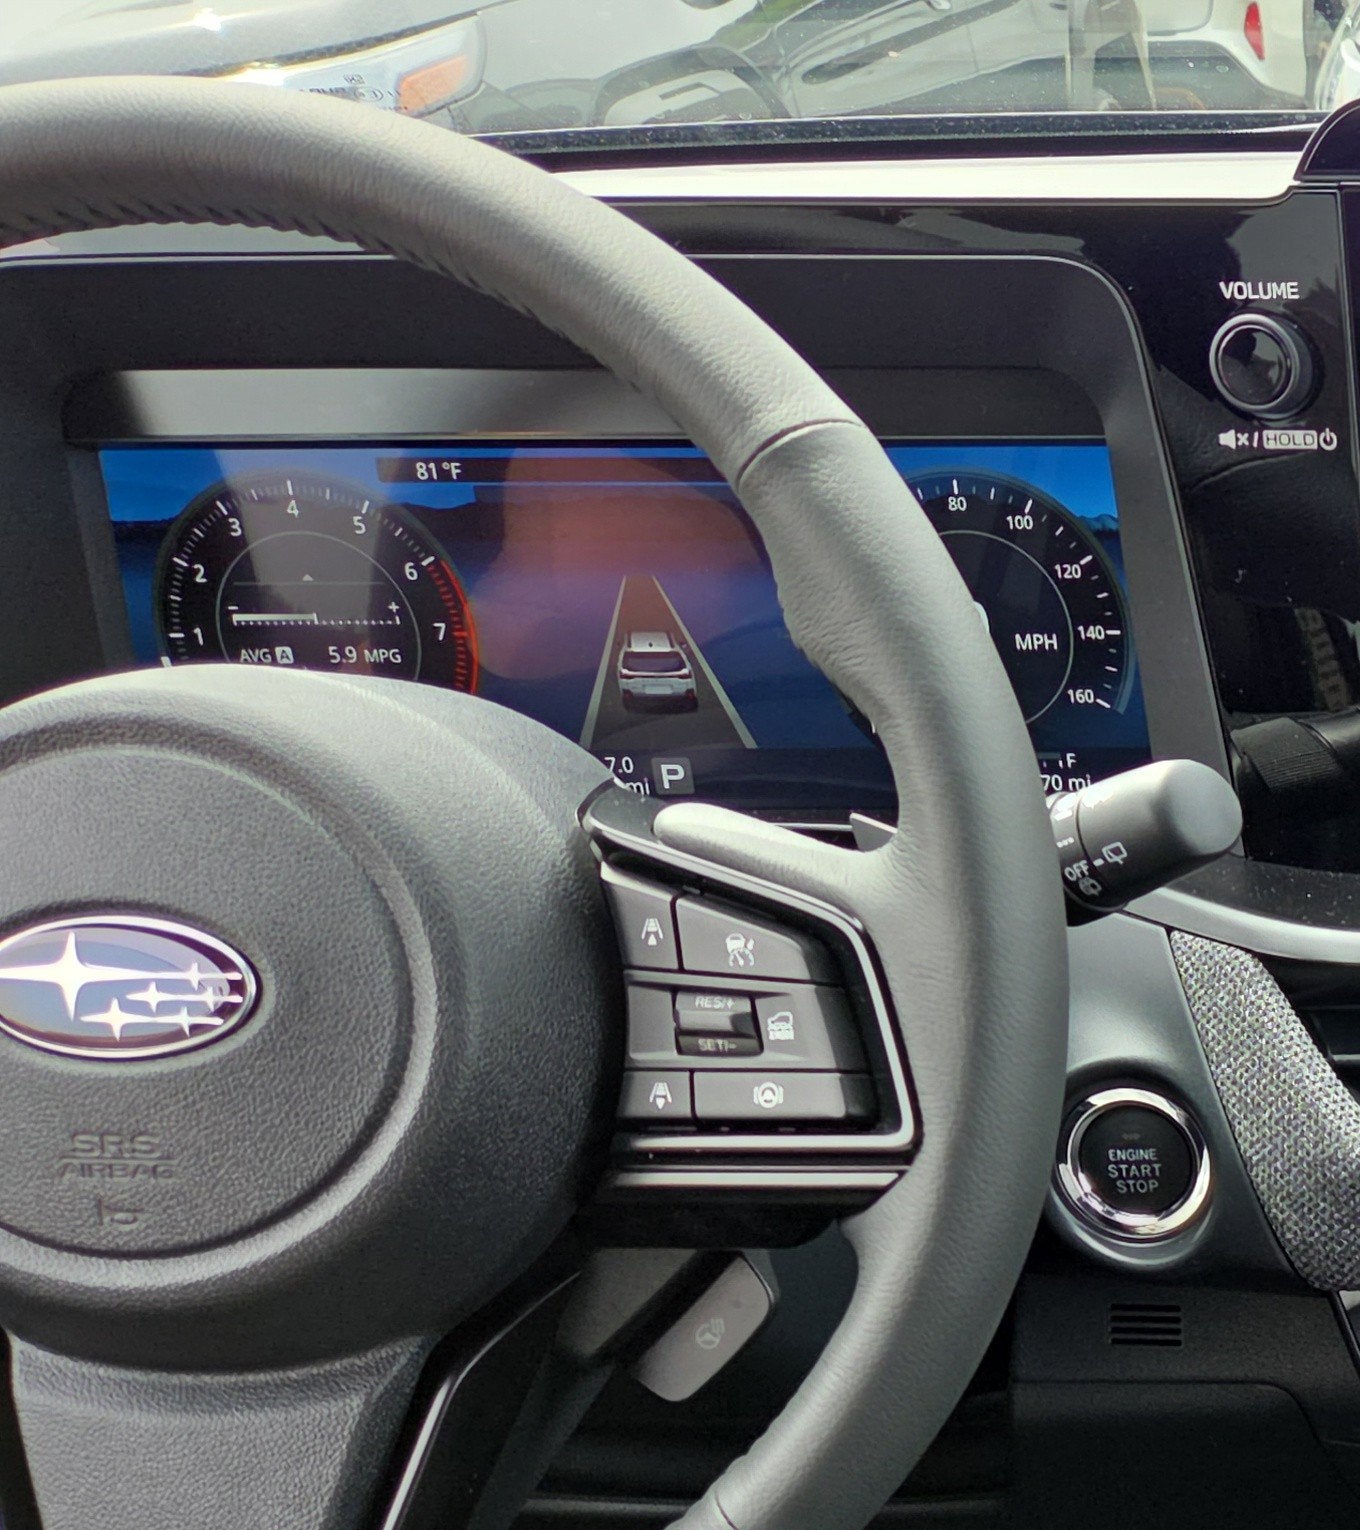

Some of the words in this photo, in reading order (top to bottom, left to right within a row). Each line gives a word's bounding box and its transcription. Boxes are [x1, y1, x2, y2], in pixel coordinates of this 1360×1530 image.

[1219, 281, 1300, 300] VOLUME
[1264, 430, 1316, 449] HOLD
[286, 499, 299, 517] 4
[947, 496, 967, 512] 80
[228, 518, 242, 536] 3
[353, 517, 366, 534] 5
[1005, 514, 1033, 531] 100
[193, 564, 207, 582] 2
[404, 562, 418, 580] 6
[1054, 563, 1081, 580] 120
[193, 627, 204, 646] 1
[433, 623, 446, 641] 7
[1077, 624, 1105, 641] 140
[1014, 632, 1058, 652] MPH
[240, 649, 271, 663] AVG
[328, 646, 357, 664] 5.9
[364, 649, 402, 663] MPG
[1067, 689, 1095, 705] 160
[1066, 753, 1076, 768] F
[661, 765, 684, 788] P
[1064, 860, 1089, 881] OFF
[1108, 1147, 1157, 1161] ENGINE
[1107, 1163, 1162, 1178] START
[1116, 1179, 1159, 1194] STOP
